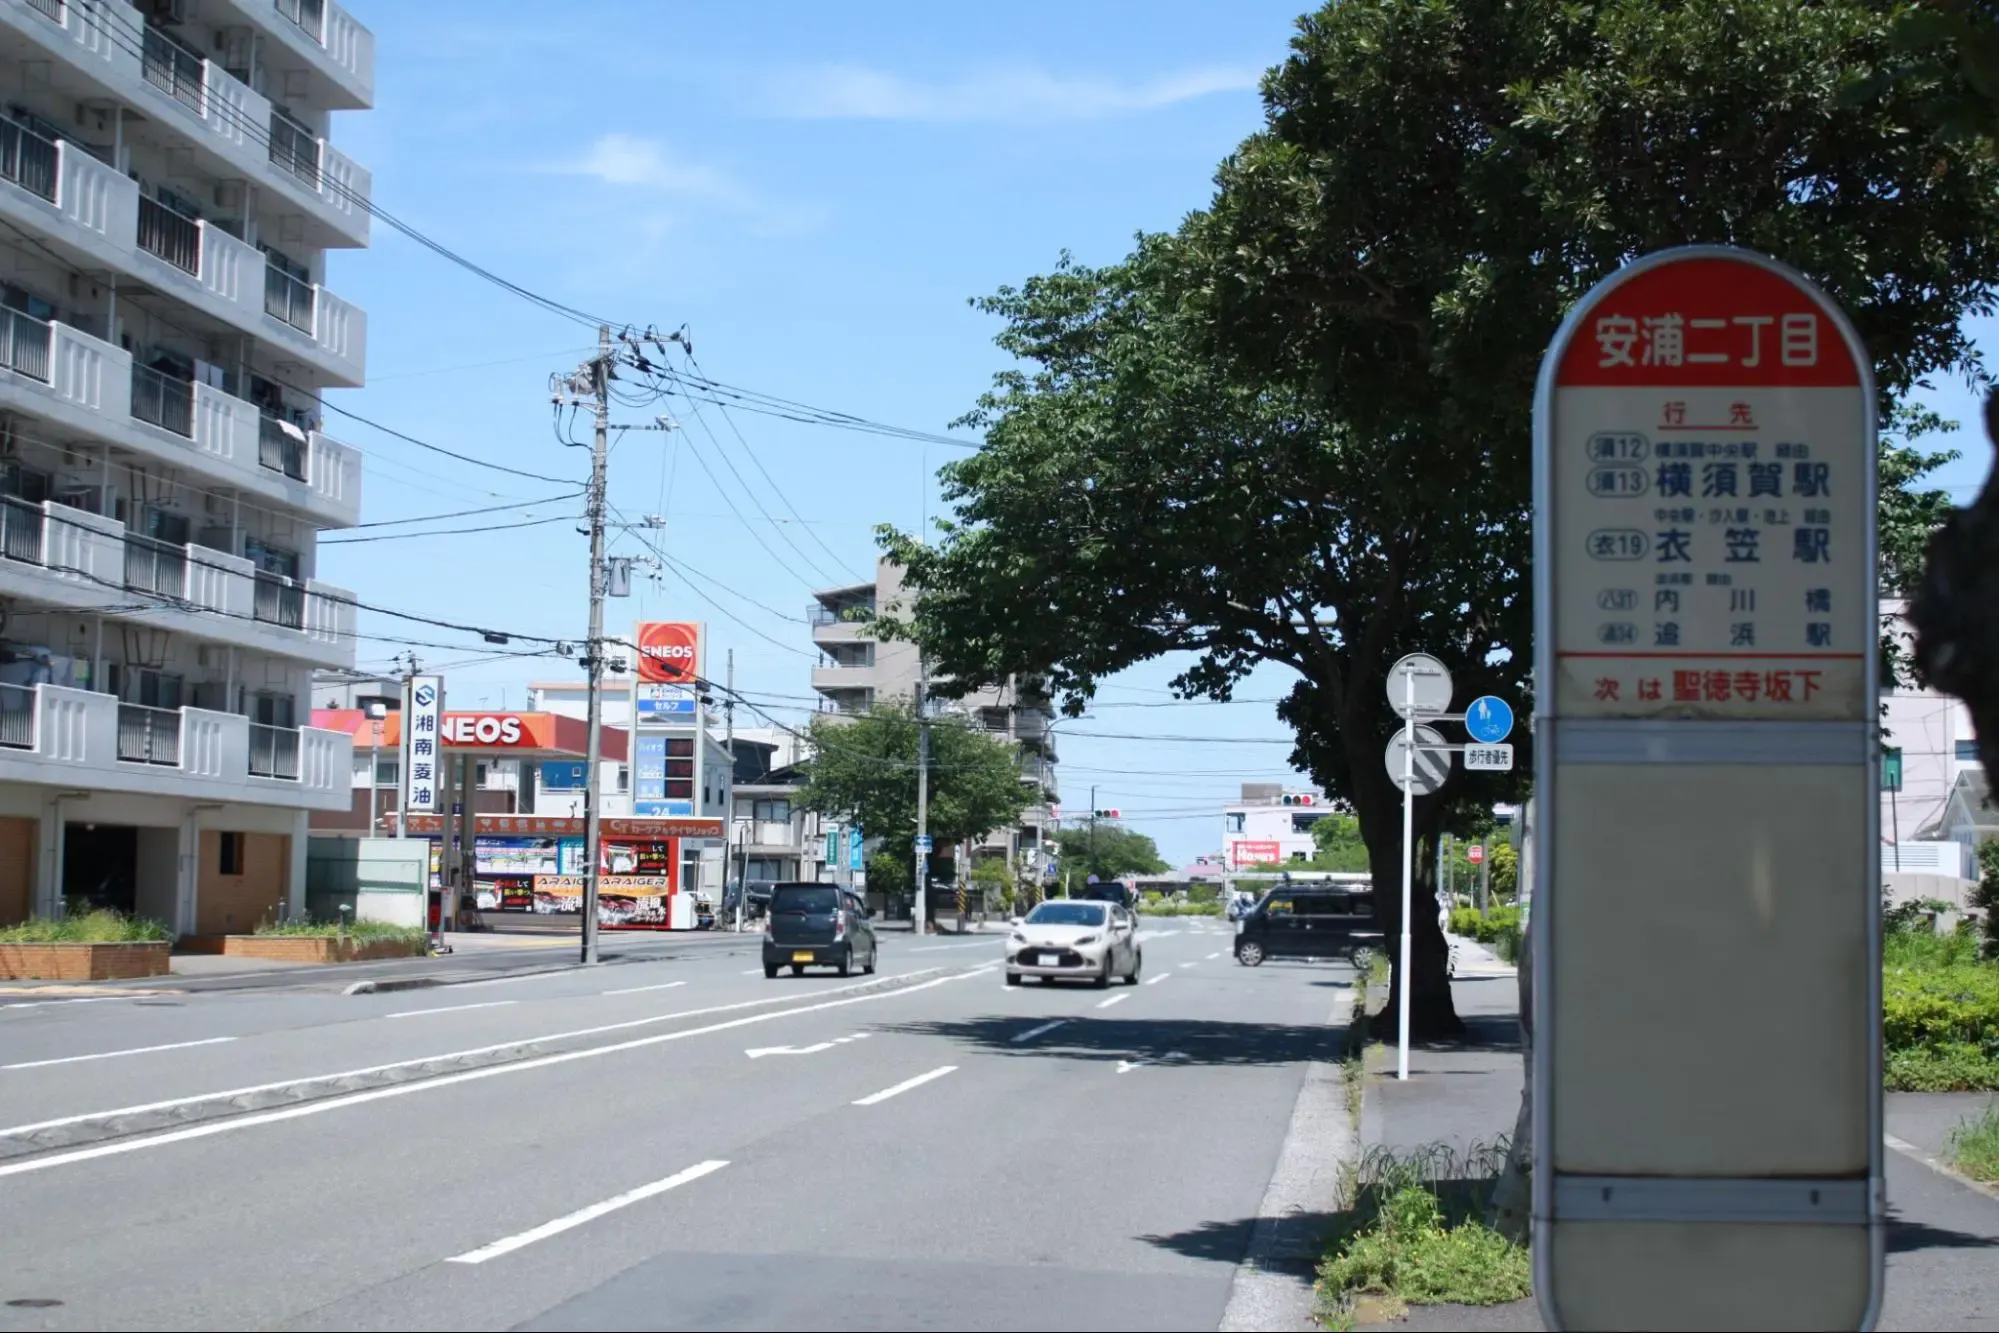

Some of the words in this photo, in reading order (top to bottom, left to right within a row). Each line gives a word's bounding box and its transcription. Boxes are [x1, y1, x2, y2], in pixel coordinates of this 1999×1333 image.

[1596, 313, 1818, 367] 安浦二丁目
[1664, 402, 1753, 424] 行先
[1594, 437, 1642, 458] 須12
[1594, 472, 1642, 493] 須13
[1656, 463, 1831, 498] 横須賀駅
[1594, 535, 1642, 556] 衣19
[1656, 528, 1831, 563] 衣笠駅
[1655, 588, 1831, 612] 内川橋
[1655, 622, 1831, 646] 追浜駅
[641, 645, 694, 658] ENEOS
[1673, 670, 1822, 701] 聖徳寺坂下
[412, 715, 434, 804] 湘南菱油
[1468, 749, 1509, 765] 歩行者優先
[537, 877, 583, 885] ARAIG
[601, 877, 666, 885] ARAIGER
